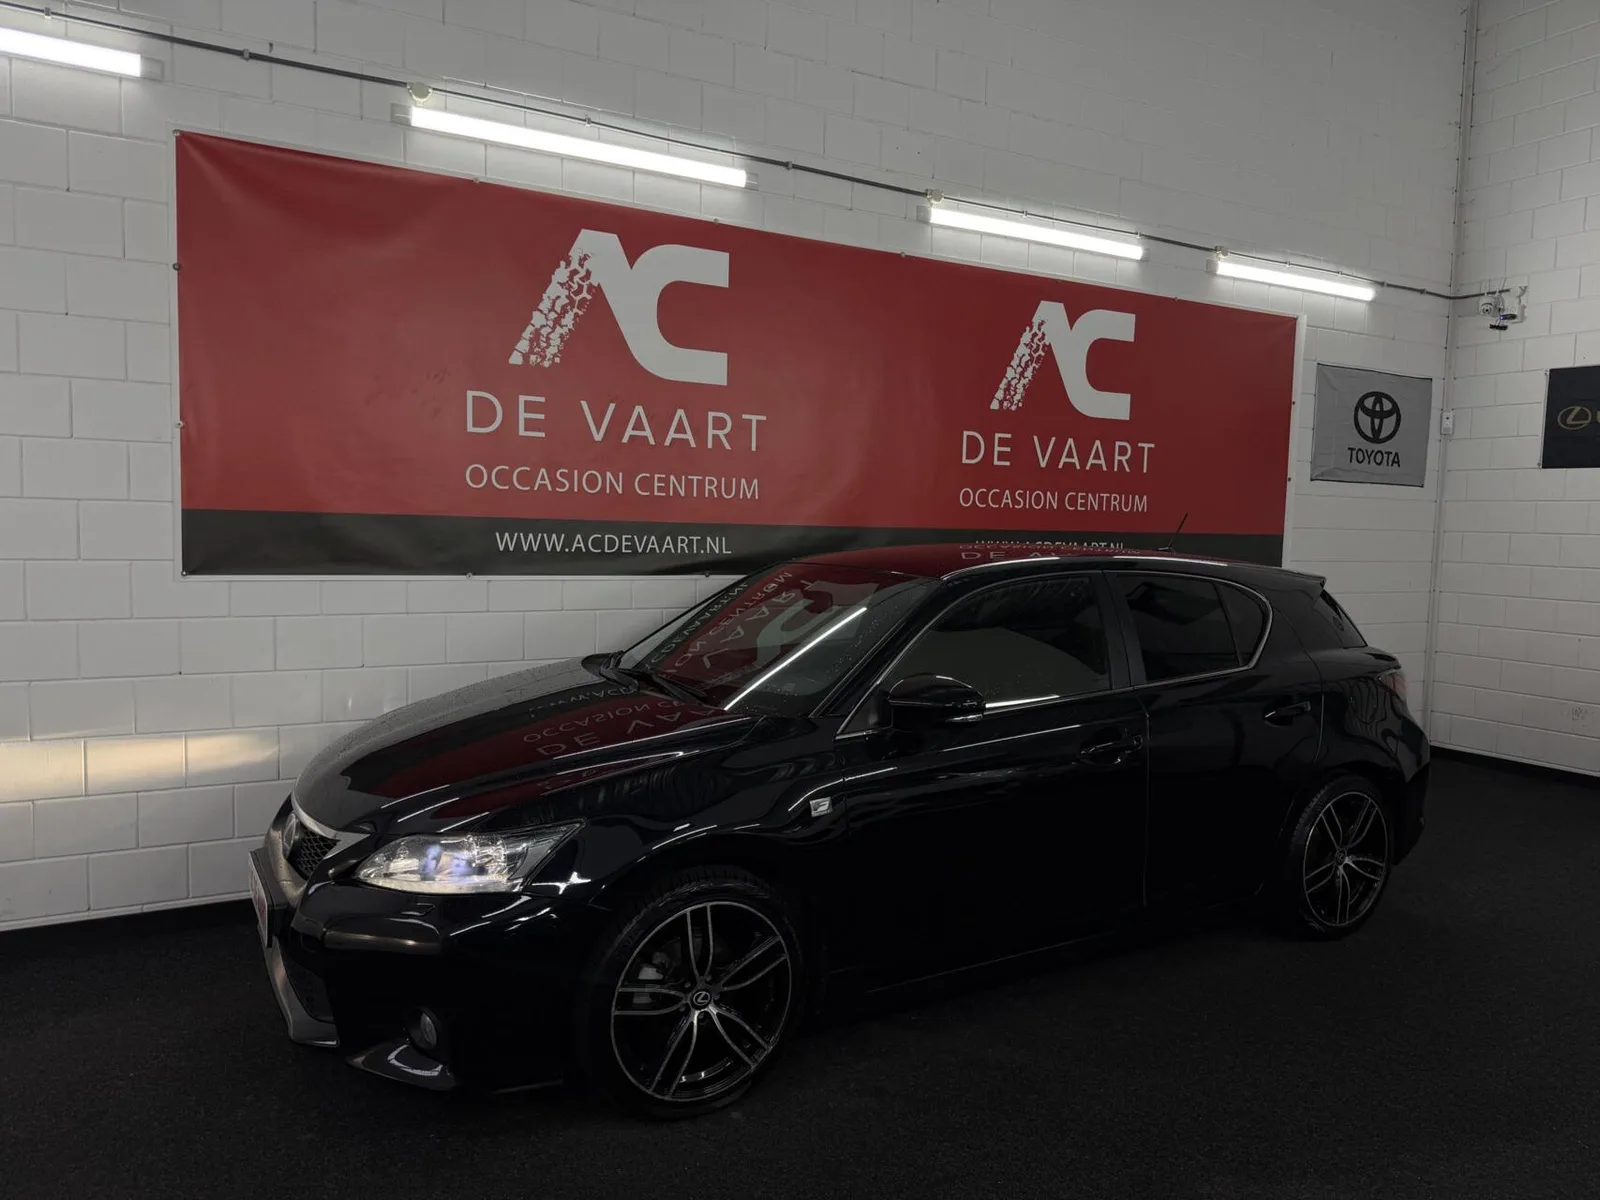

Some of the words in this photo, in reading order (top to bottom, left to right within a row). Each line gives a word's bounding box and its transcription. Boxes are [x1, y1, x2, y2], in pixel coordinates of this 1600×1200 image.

[508, 228, 730, 386] AC
[989, 300, 1136, 421] AC
[466, 389, 546, 438] DE
[580, 400, 767, 452] VAART
[961, 430, 1012, 466] DE
[1033, 435, 1155, 473] VAART
[1347, 446, 1401, 468] TOYOTA
[465, 463, 623, 495] OCCASION
[634, 472, 760, 500] CENTRUM
[959, 487, 1058, 510] OCCASION
[1064, 491, 1148, 513] CENTRUM
[495, 531, 732, 555] WWW.ACDEVAART.NL
